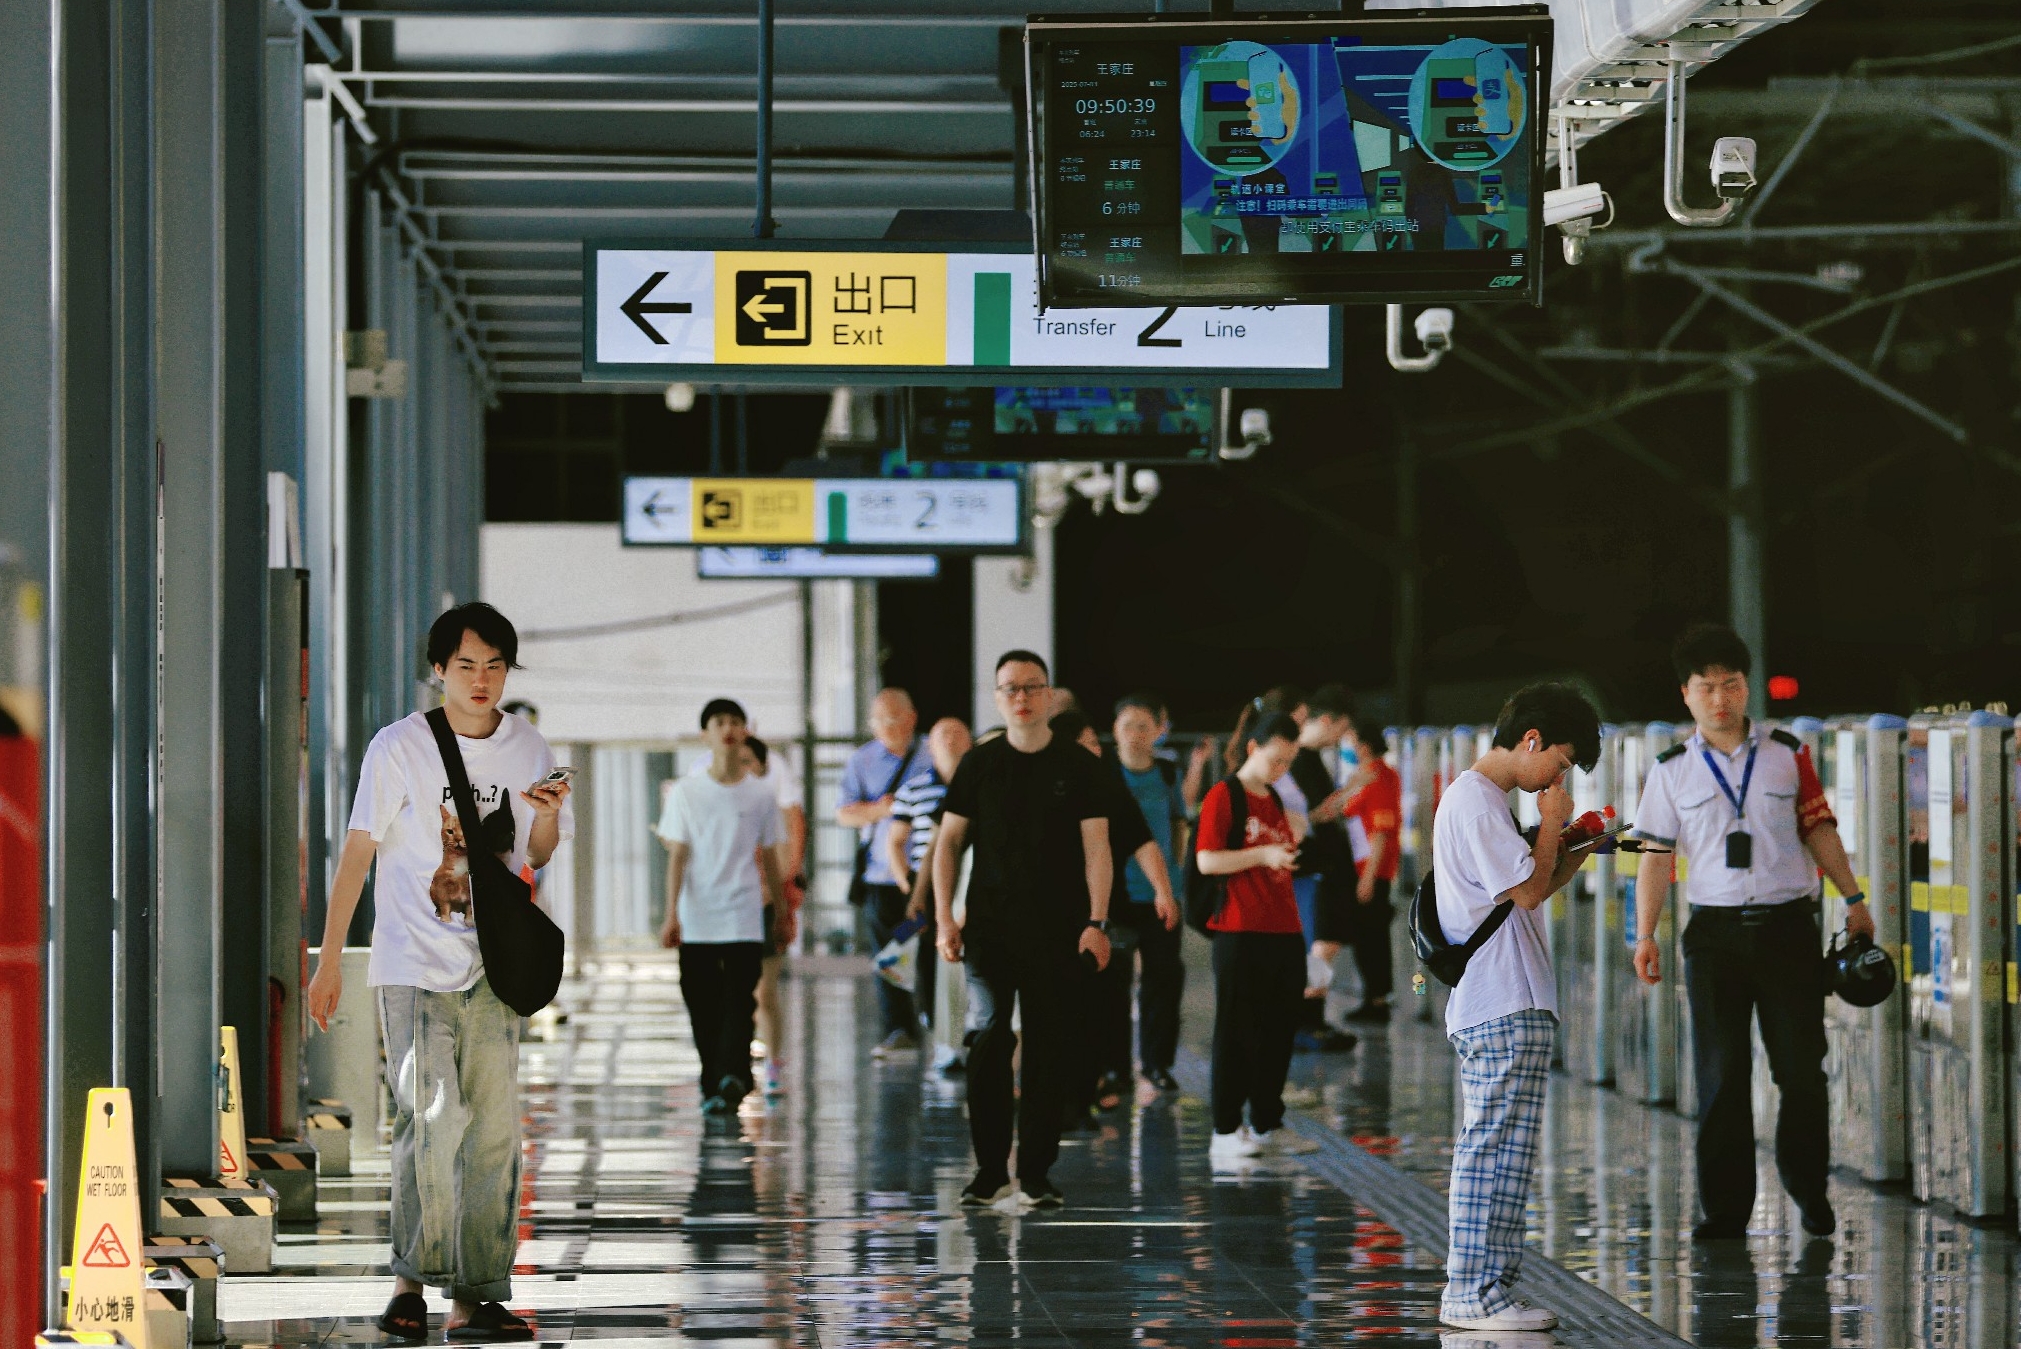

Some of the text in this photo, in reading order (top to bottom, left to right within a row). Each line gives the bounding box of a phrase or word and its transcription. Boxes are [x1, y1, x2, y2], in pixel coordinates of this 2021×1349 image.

[1097, 62, 1134, 76] 王家庄
[1075, 98, 1156, 114] 09:50:39
[1079, 130, 1105, 138] 06:24
[1130, 129, 1156, 138] 23:14
[1108, 159, 1142, 170] 王家庄
[1109, 237, 1143, 248] 王家庄
[834, 271, 916, 315] 出口
[833, 324, 884, 345] Exit
[1033, 318, 1117, 336] Transfer
[1204, 320, 1247, 338] Line
[915, 490, 939, 529] 2
[442, 783, 498, 804] ph..?
[90, 1165, 124, 1180] CAUTION
[86, 1183, 127, 1197] WET FLOOR
[75, 1296, 135, 1323] 小心地滑
